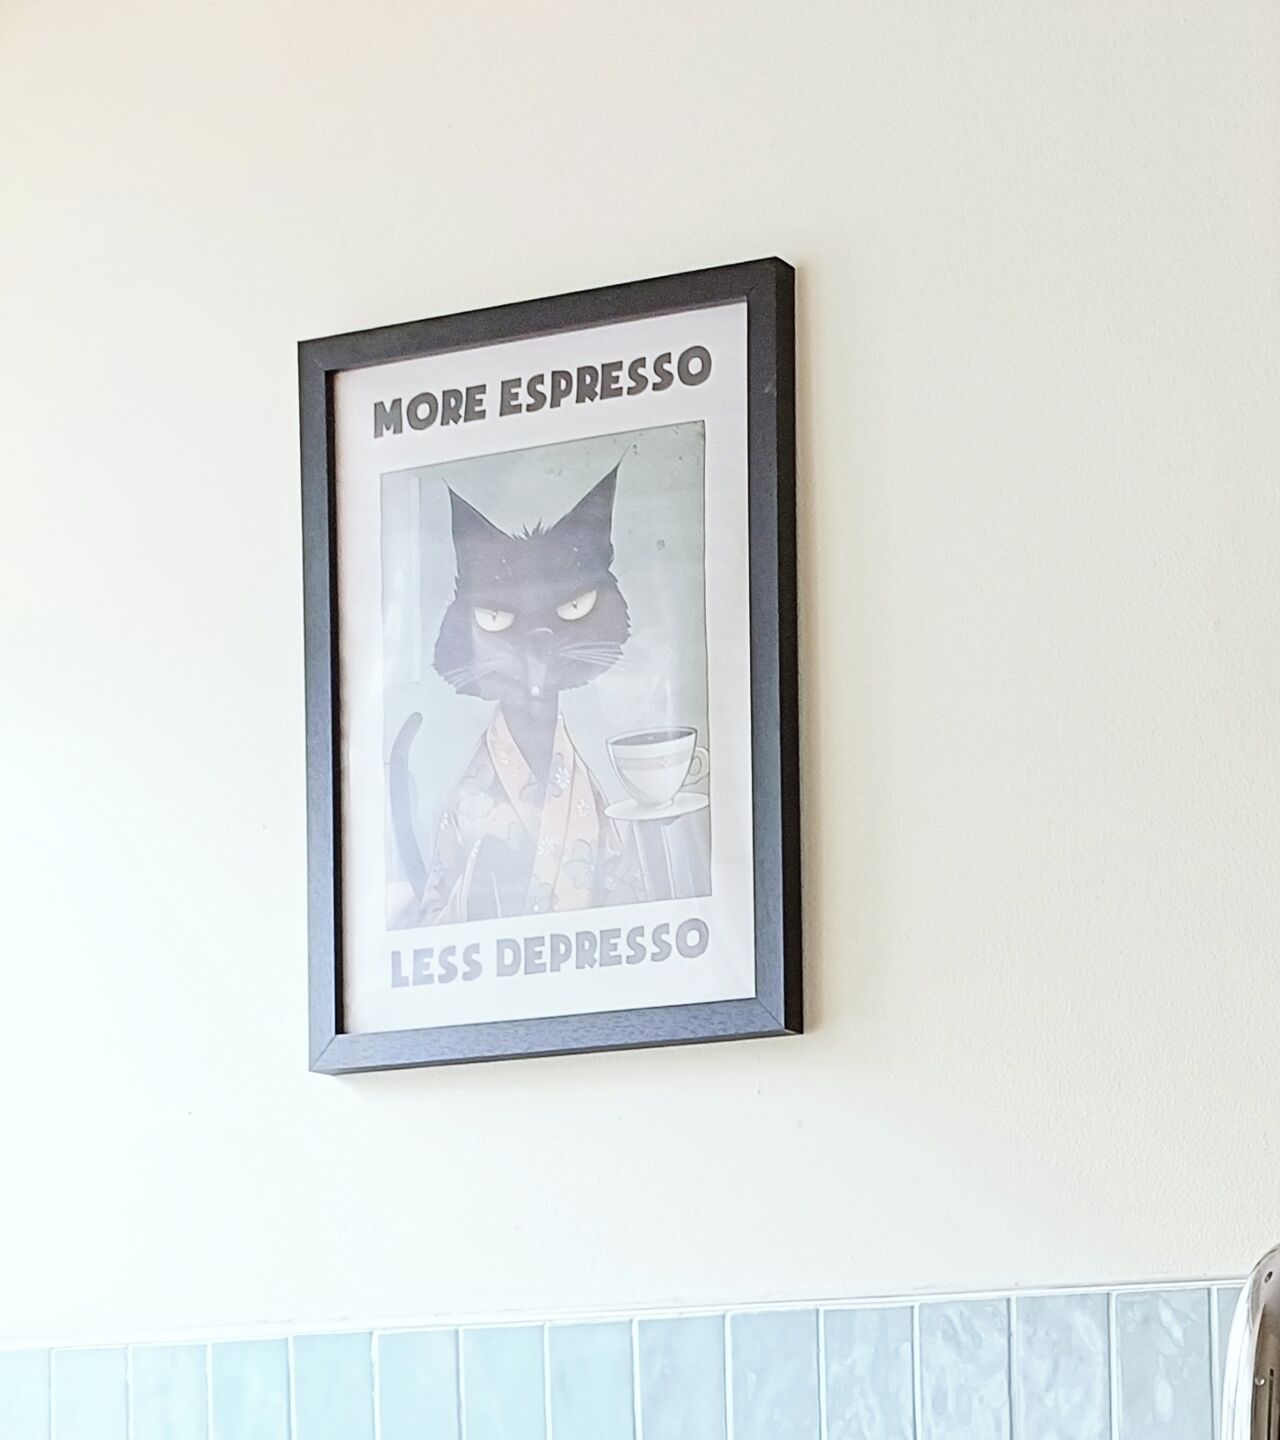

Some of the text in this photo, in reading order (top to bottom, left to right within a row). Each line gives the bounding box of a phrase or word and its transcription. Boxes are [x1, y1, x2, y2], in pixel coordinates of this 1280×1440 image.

[374, 345, 713, 439] MORE ESPRESSO
[391, 918, 709, 989] LESS DEPRESSO
